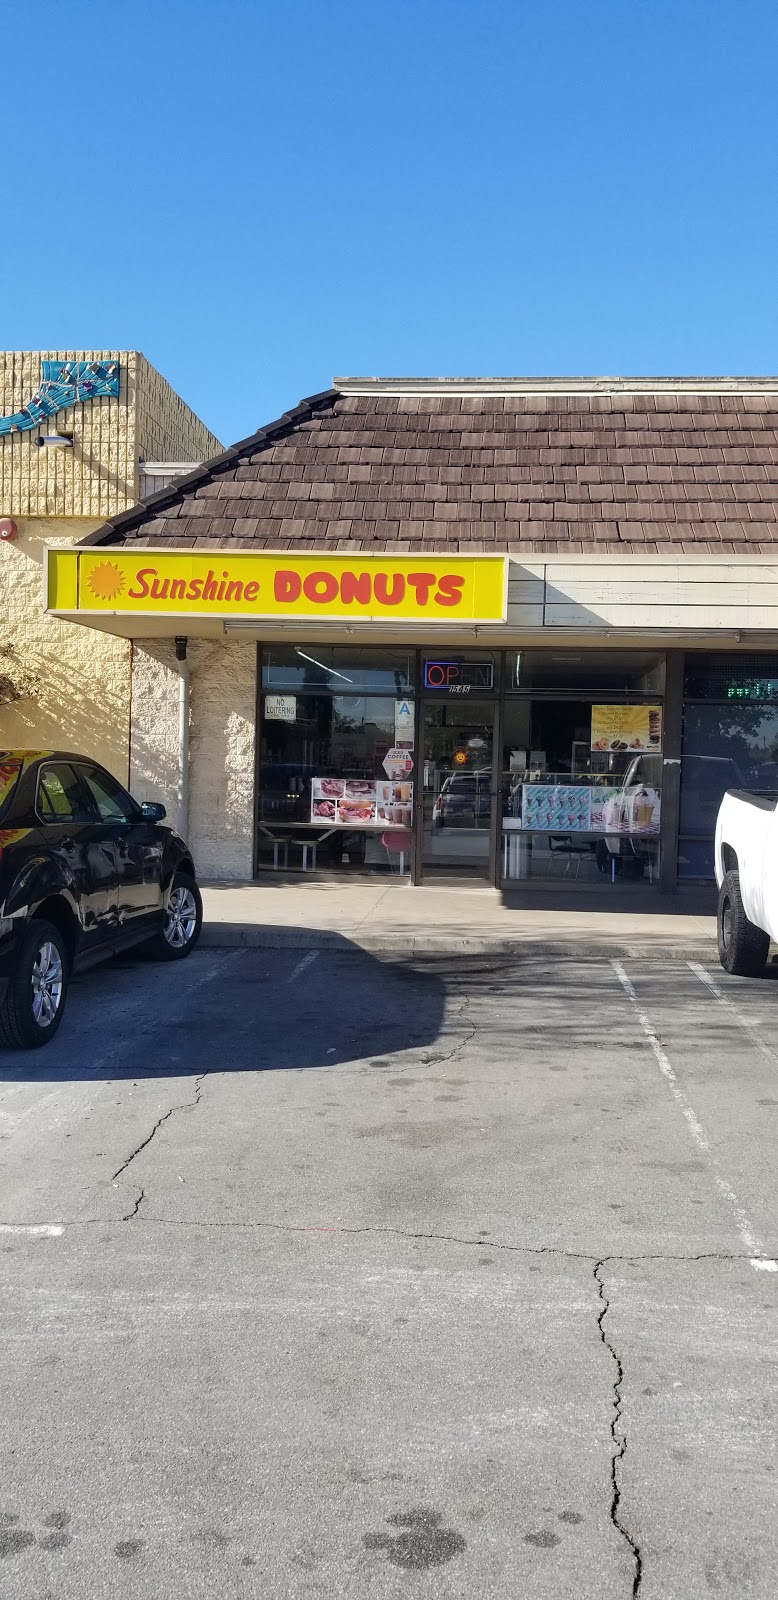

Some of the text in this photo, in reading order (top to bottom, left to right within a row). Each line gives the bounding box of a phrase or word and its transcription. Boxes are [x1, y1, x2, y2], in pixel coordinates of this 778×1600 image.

[128, 568, 466, 607] Sunshine DONUTS
[427, 664, 490, 687] OPEN
[448, 684, 471, 694] 1545
[276, 698, 285, 706] NO
[266, 706, 295, 715] LOITERING
[398, 702, 411, 715] A
